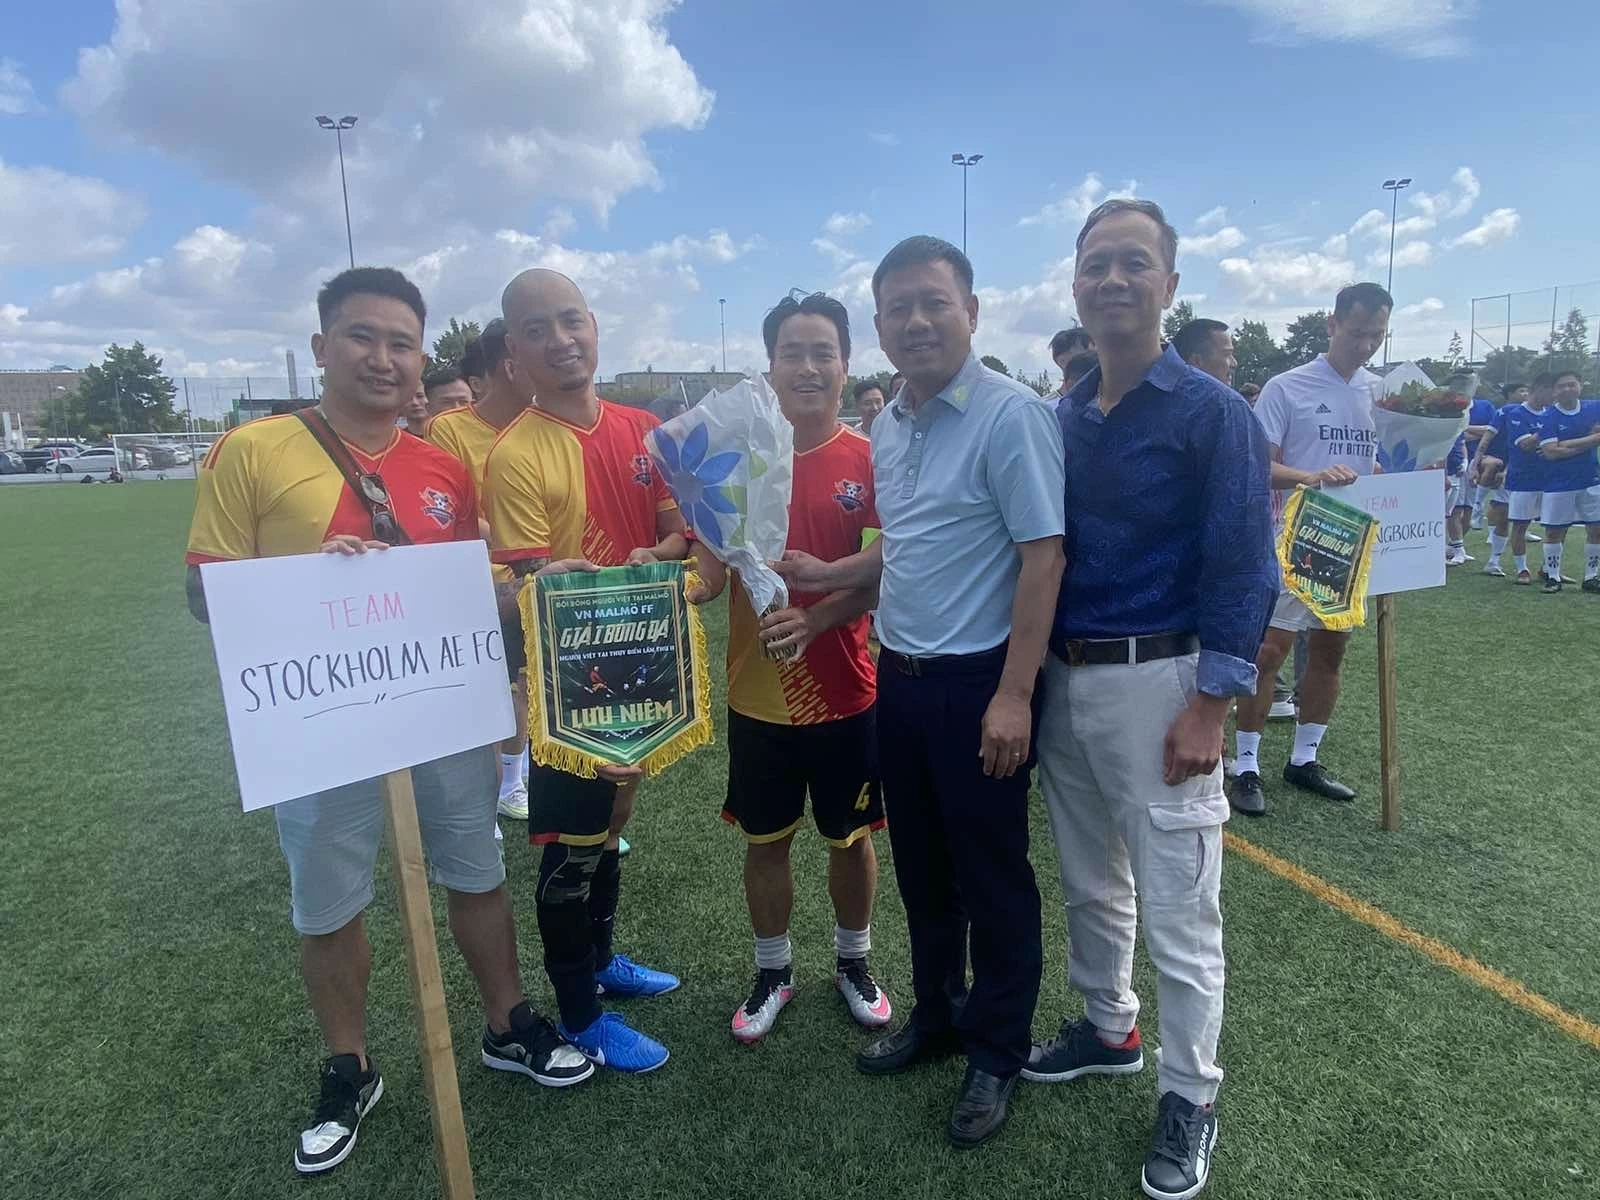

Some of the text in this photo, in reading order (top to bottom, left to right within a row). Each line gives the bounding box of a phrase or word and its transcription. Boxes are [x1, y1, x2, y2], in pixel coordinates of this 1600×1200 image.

[1319, 425, 1377, 444] Emirate
[1328, 442, 1343, 456] FLY
[1428, 520, 1443, 538] FC
[319, 591, 405, 630] TEAM
[574, 602, 655, 620] VN MALMÖ FF
[240, 630, 503, 713] STOCKHOLM AE FC
[854, 782, 870, 811] 4
